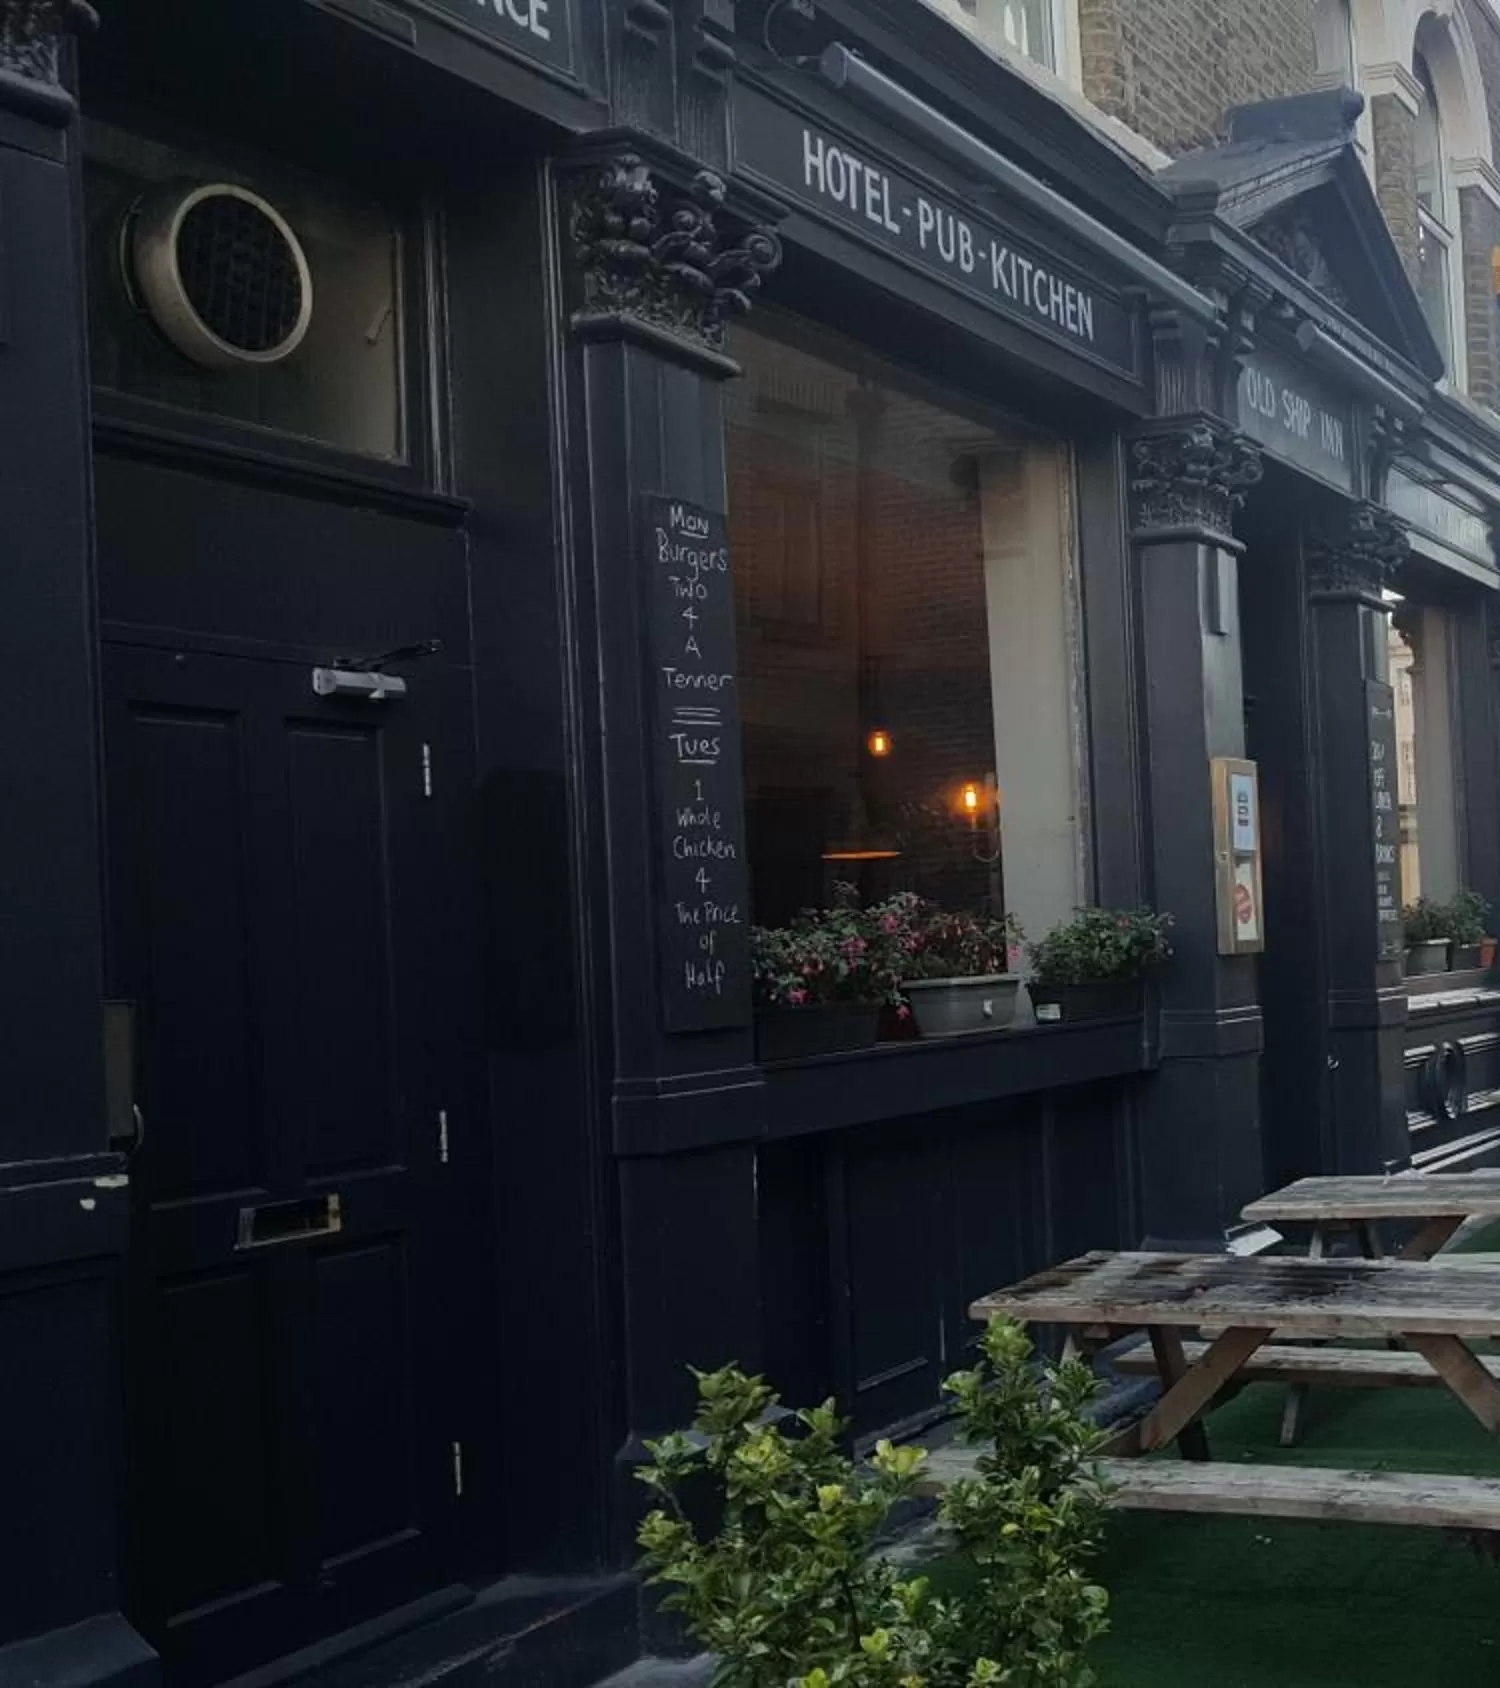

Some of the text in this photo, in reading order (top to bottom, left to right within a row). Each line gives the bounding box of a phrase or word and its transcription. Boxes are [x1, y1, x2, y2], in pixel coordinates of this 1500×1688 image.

[803, 130, 900, 234] HOTEL
[918, 198, 974, 273] PUB
[991, 241, 1094, 341] KITCHEN
[1247, 367, 1344, 461] OLD SHIP INN
[655, 527, 728, 580] Burgers
[681, 606, 698, 630] 4
[684, 636, 701, 659] A
[662, 667, 733, 691] Tenner
[668, 733, 721, 757] Tues
[694, 779, 704, 801] 1
[677, 808, 721, 830] Whole
[673, 835, 736, 859] Chicken
[695, 867, 712, 894] 4
[674, 901, 741, 924] The Price
[699, 929, 717, 955] of
[685, 960, 725, 994] Half
